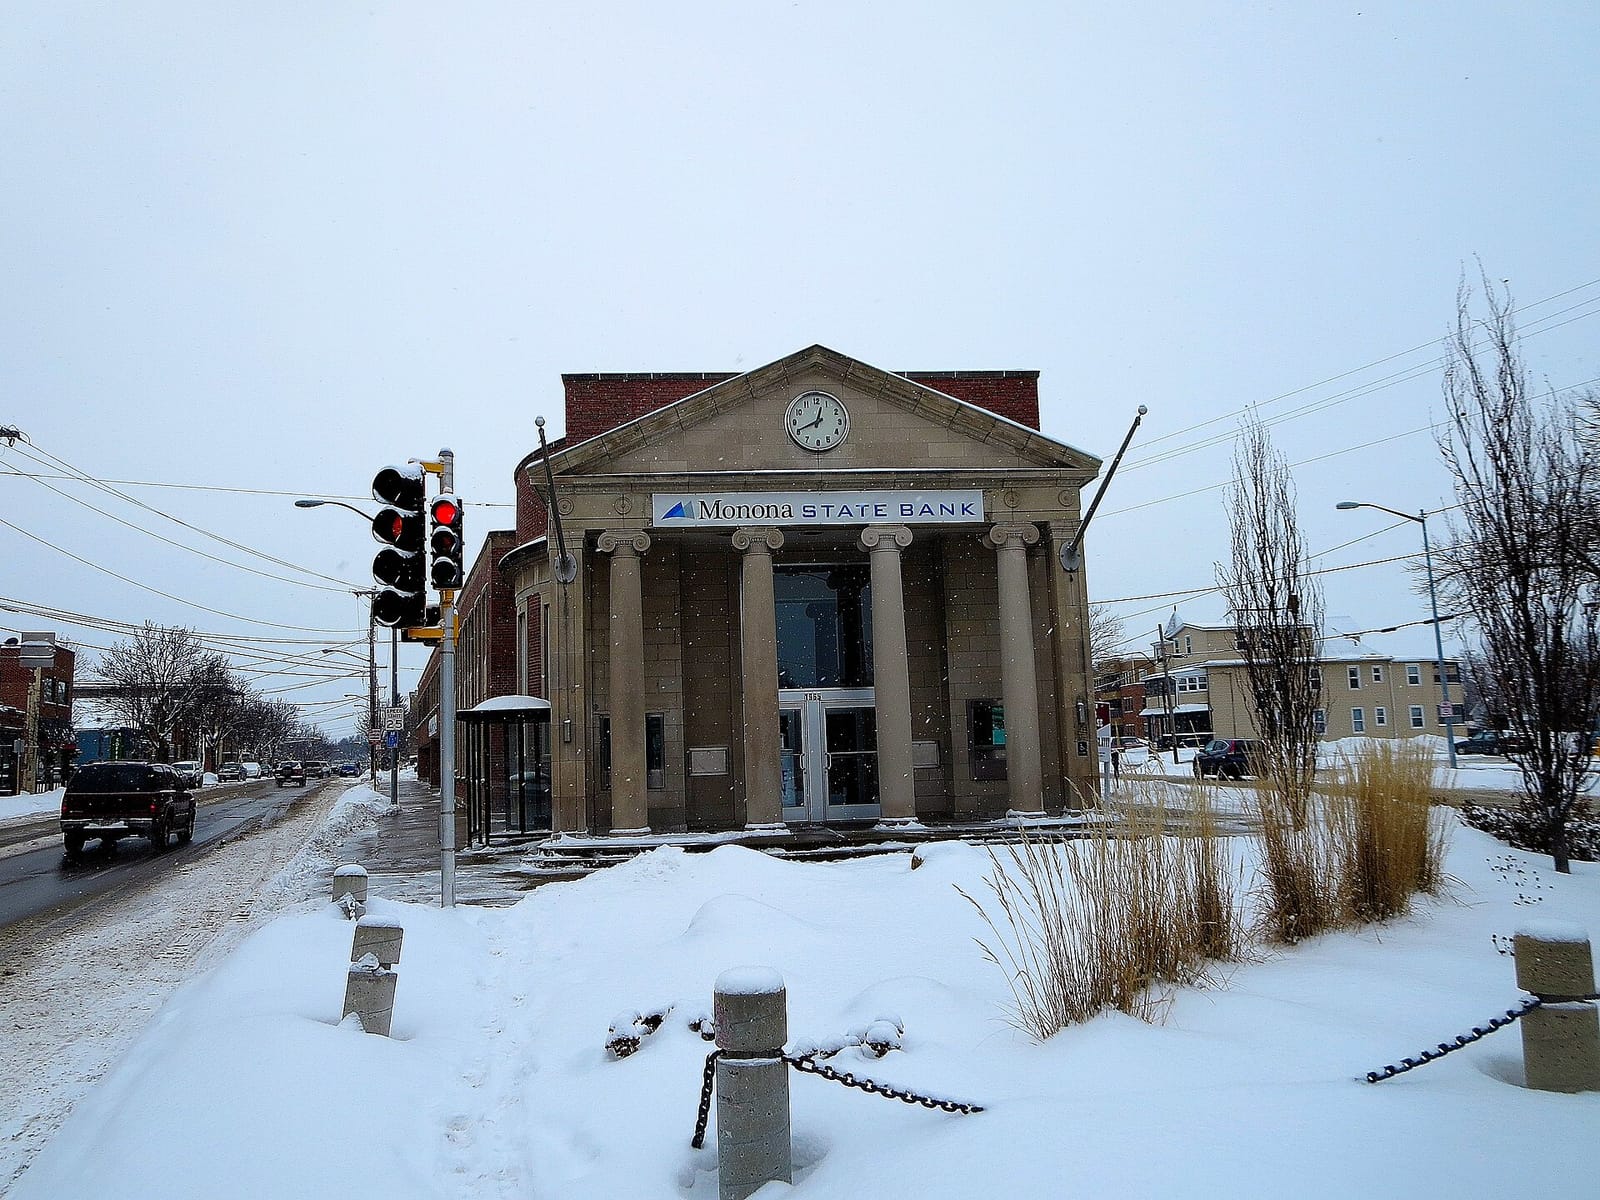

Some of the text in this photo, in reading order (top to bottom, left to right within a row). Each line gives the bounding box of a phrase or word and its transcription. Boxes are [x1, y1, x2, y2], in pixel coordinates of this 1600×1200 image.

[803, 400, 809, 408] 11
[813, 397, 820, 405] 12
[833, 408, 839, 416] 2
[837, 418, 842, 426] 3
[698, 499, 977, 520] Monona STATE BANK
[386, 719, 403, 729] 25
